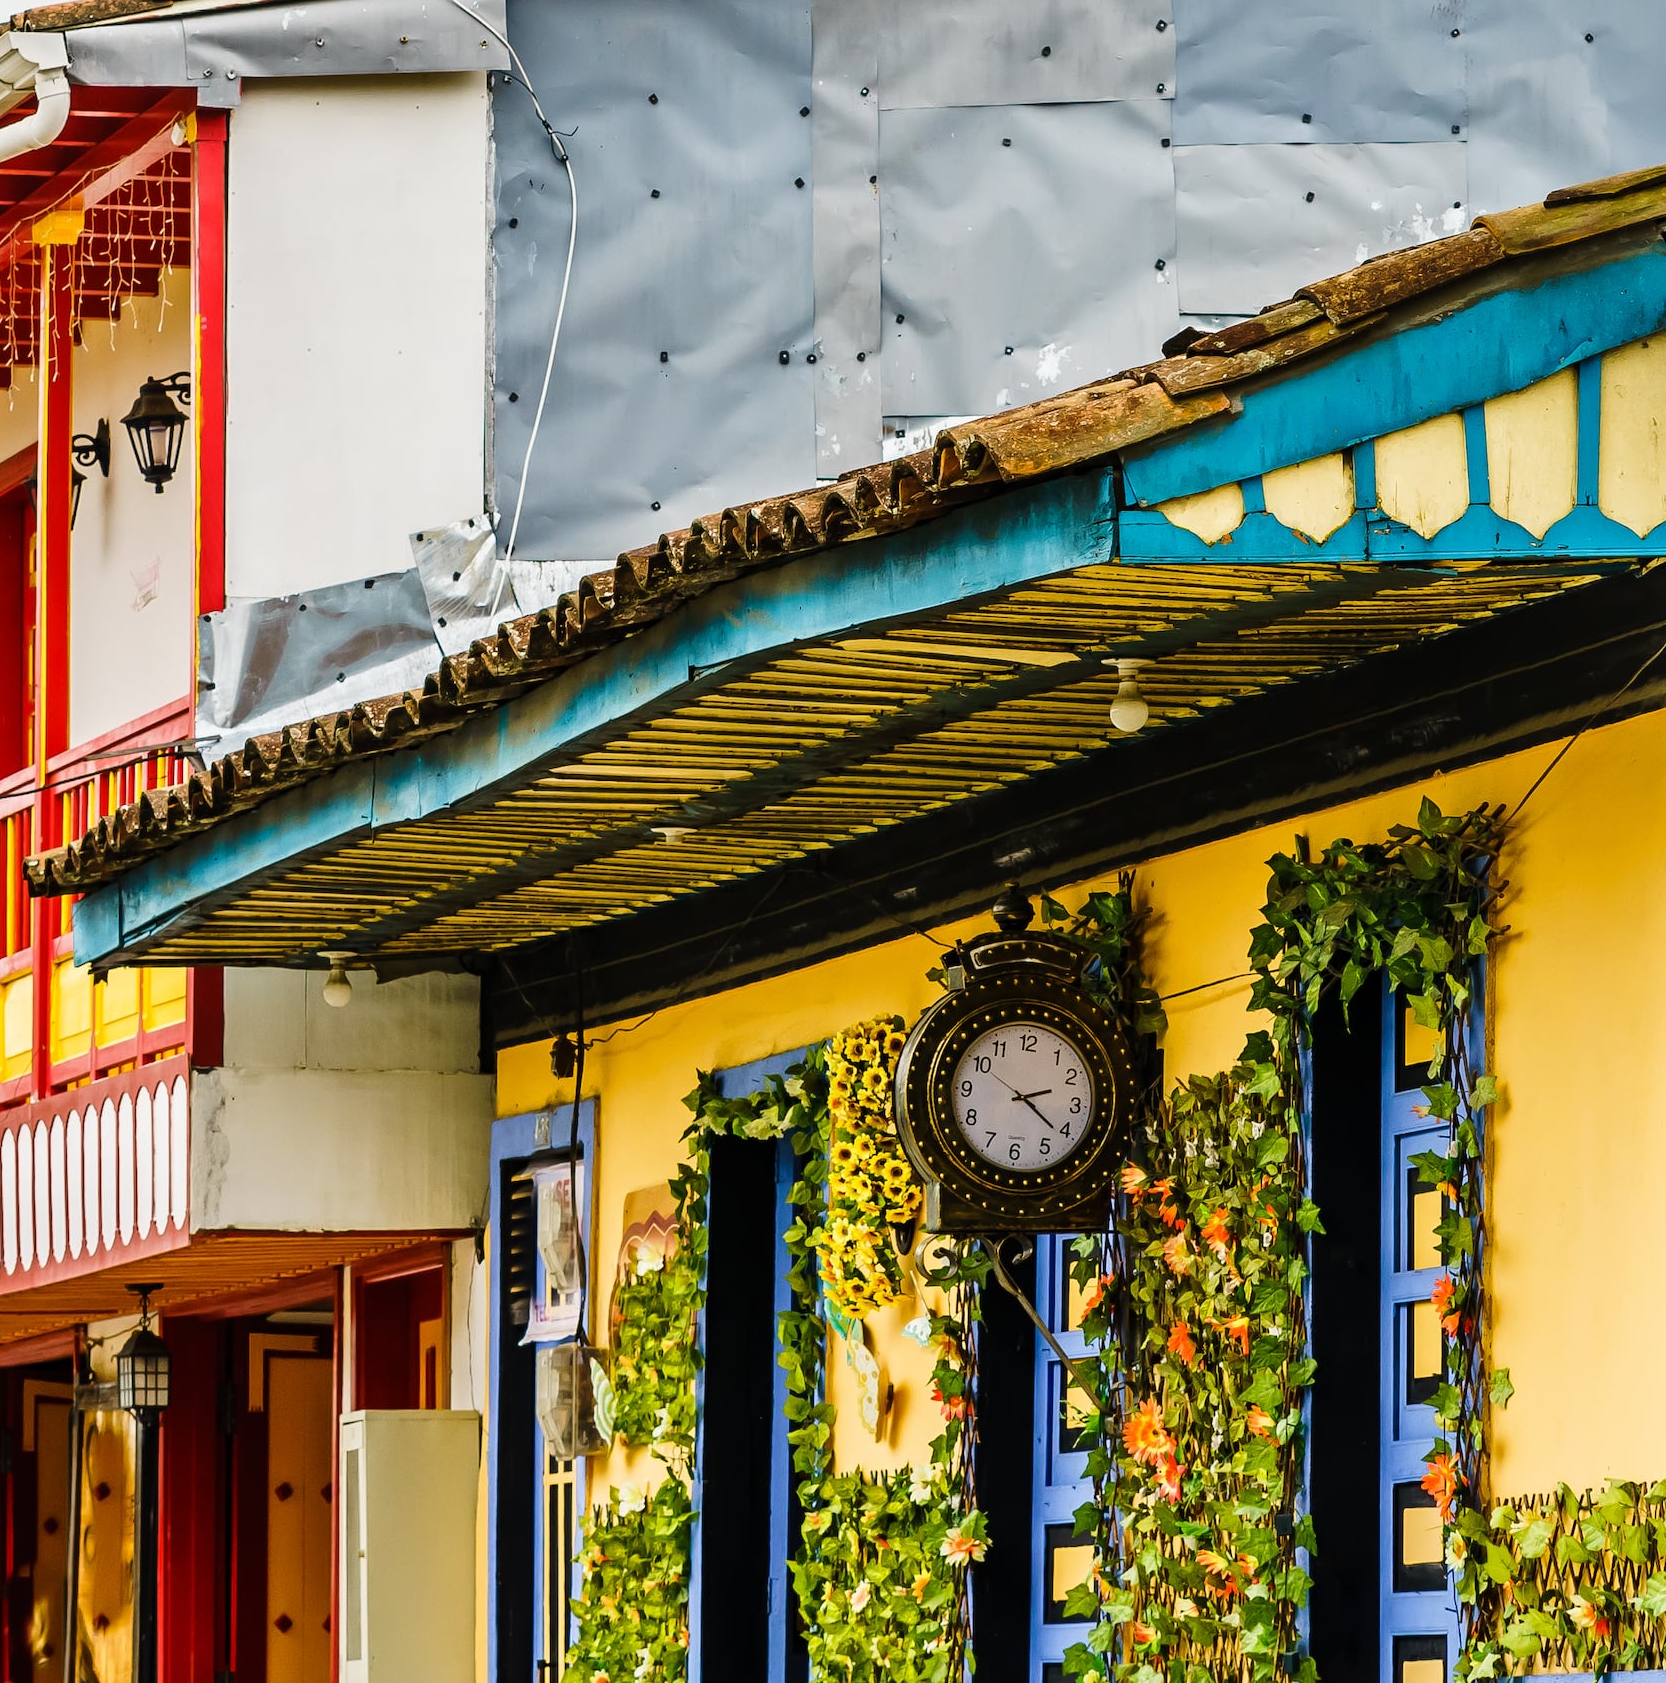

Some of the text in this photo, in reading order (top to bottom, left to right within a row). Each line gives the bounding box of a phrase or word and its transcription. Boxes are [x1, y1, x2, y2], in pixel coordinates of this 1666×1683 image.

[992, 1040, 1006, 1058] 11
[1019, 1034, 1038, 1053] 12
[973, 1055, 991, 1074] 10
[1053, 1049, 1061, 1066] 1
[1065, 1068, 1077, 1086] 2
[960, 1080, 973, 1098] 9
[1069, 1097, 1081, 1114] 3
[965, 1108, 977, 1126] 8
[1059, 1121, 1071, 1139] 4
[985, 1131, 997, 1148] 7
[1039, 1137, 1051, 1155] 5
[1009, 1143, 1021, 1161] 6
